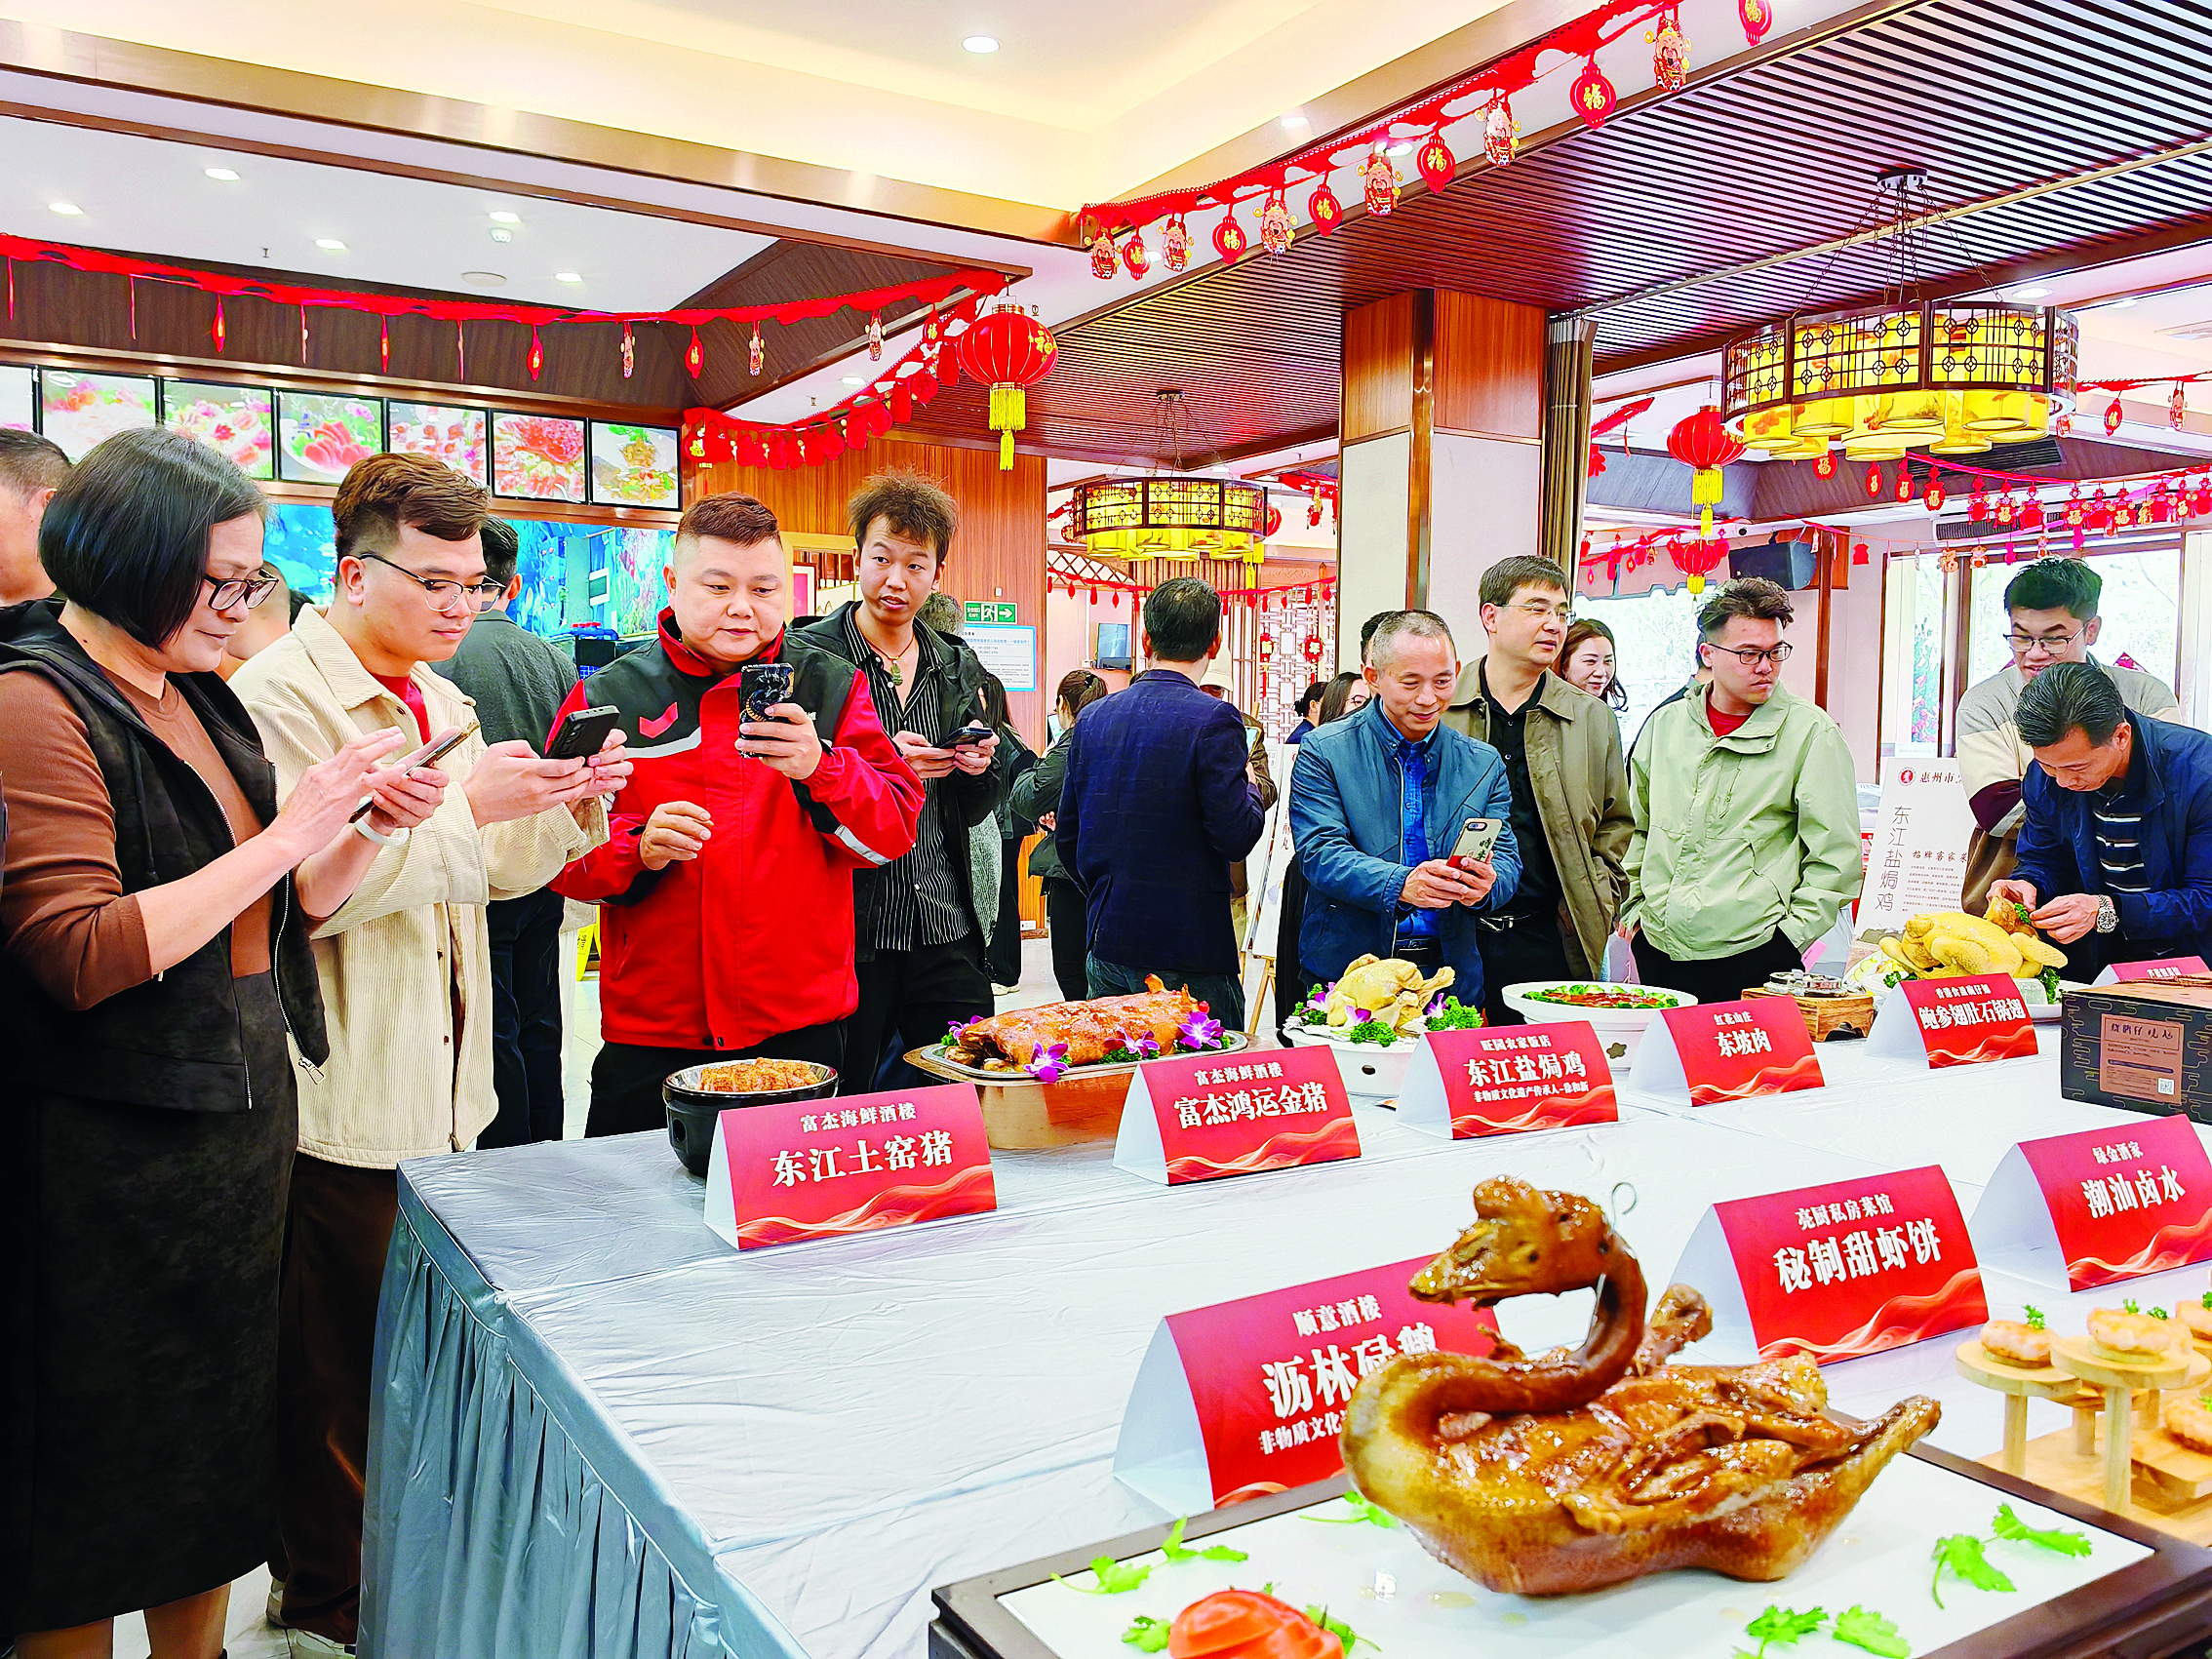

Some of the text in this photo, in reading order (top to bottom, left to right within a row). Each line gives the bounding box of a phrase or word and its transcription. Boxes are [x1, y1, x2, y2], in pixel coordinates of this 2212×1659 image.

[1583, 85, 1606, 111] 福
[1427, 146, 1447, 172] 福
[1317, 198, 1333, 220] 福
[1224, 229, 1241, 250] 福
[1130, 247, 1144, 265] 福
[1817, 456, 1832, 476] 福
[1927, 490, 1940, 507] 福
[1875, 805, 1913, 912] 东江盐焗鸡
[1713, 1010, 1755, 1026] 红花山庄
[1917, 996, 2028, 1031] 鲍参翅肚石锅翅
[1479, 1034, 1553, 1052] 旺园农家饭店
[1714, 1027, 1773, 1058] 东坡肉
[1193, 1061, 1284, 1087] 富杰海鲜酒楼
[1462, 1049, 1588, 1088] 东江盐焗鸡
[799, 1101, 918, 1133] 富杰海鲜酒楼
[1172, 1081, 1329, 1130] 富杰鸿运金猪
[769, 1128, 954, 1188] 东江土窑猪
[2091, 1140, 2144, 1165] 绿金酒家
[2080, 1165, 2187, 1219] 潮汕卤水
[1794, 1192, 1895, 1232] 亮厨私房菜馆
[1772, 1217, 1943, 1294] 秘制甜虾饼
[1291, 1293, 1384, 1338] 顺意酒楼
[1258, 1409, 1350, 1456] 非物质文化
